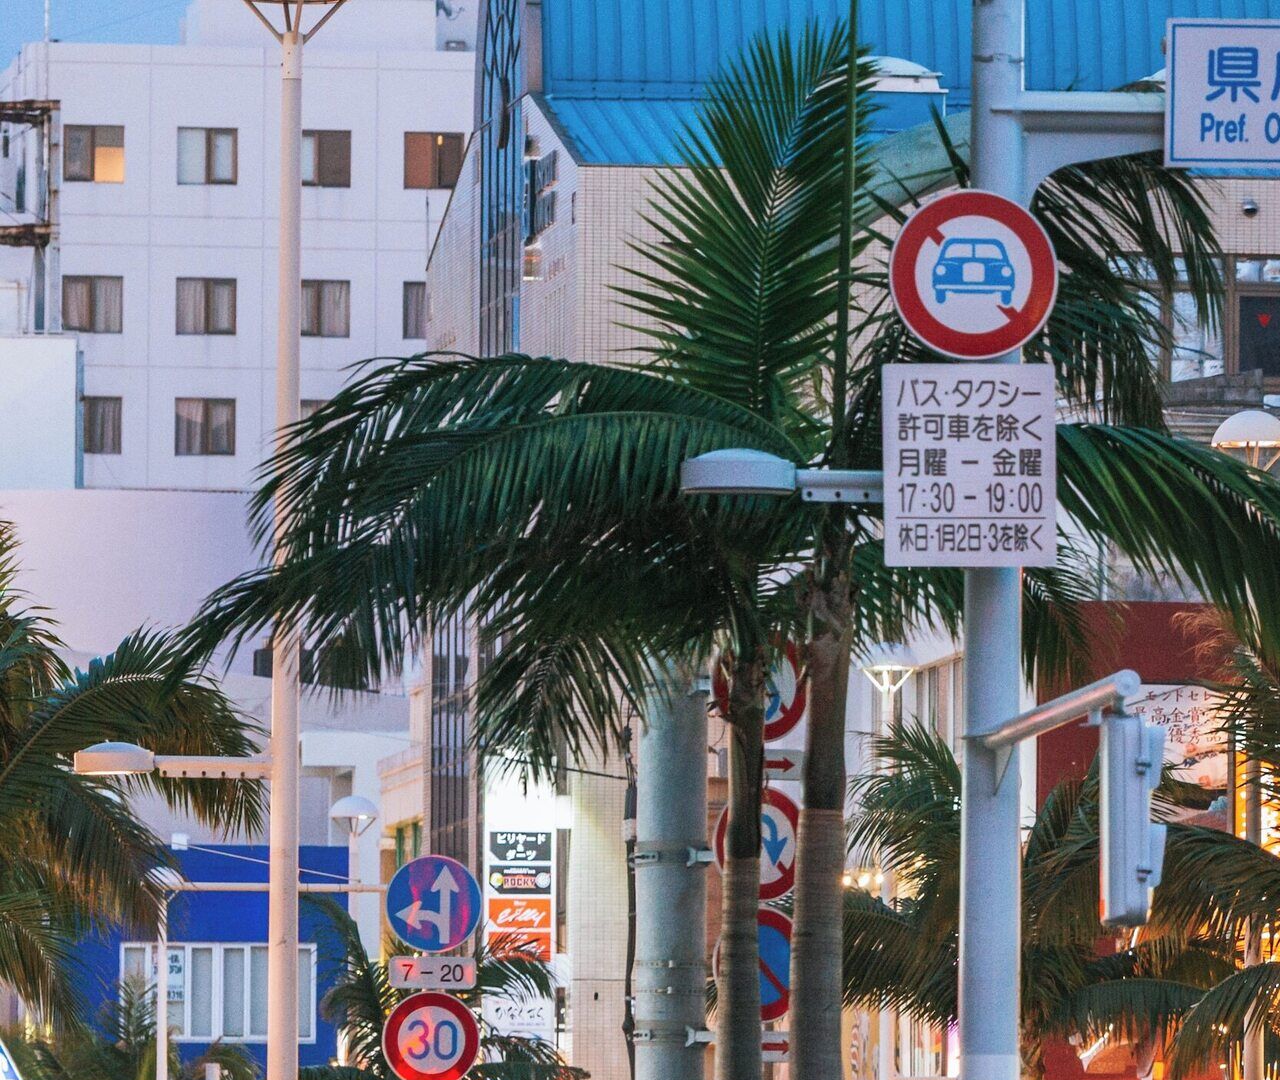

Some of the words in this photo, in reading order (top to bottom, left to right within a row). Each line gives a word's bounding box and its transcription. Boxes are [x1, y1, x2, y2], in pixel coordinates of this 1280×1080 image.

[1199, 112, 1249, 143] Pref.
[896, 379, 1042, 408] バス・タクシー
[897, 413, 1042, 442] 許可車を除く
[897, 448, 947, 478] 月曜
[992, 447, 1042, 477] 金曜
[897, 482, 955, 513] 17:30
[985, 482, 1043, 513] 19:00
[503, 876, 537, 888] ROCKY
[407, 1020, 458, 1060] 30
